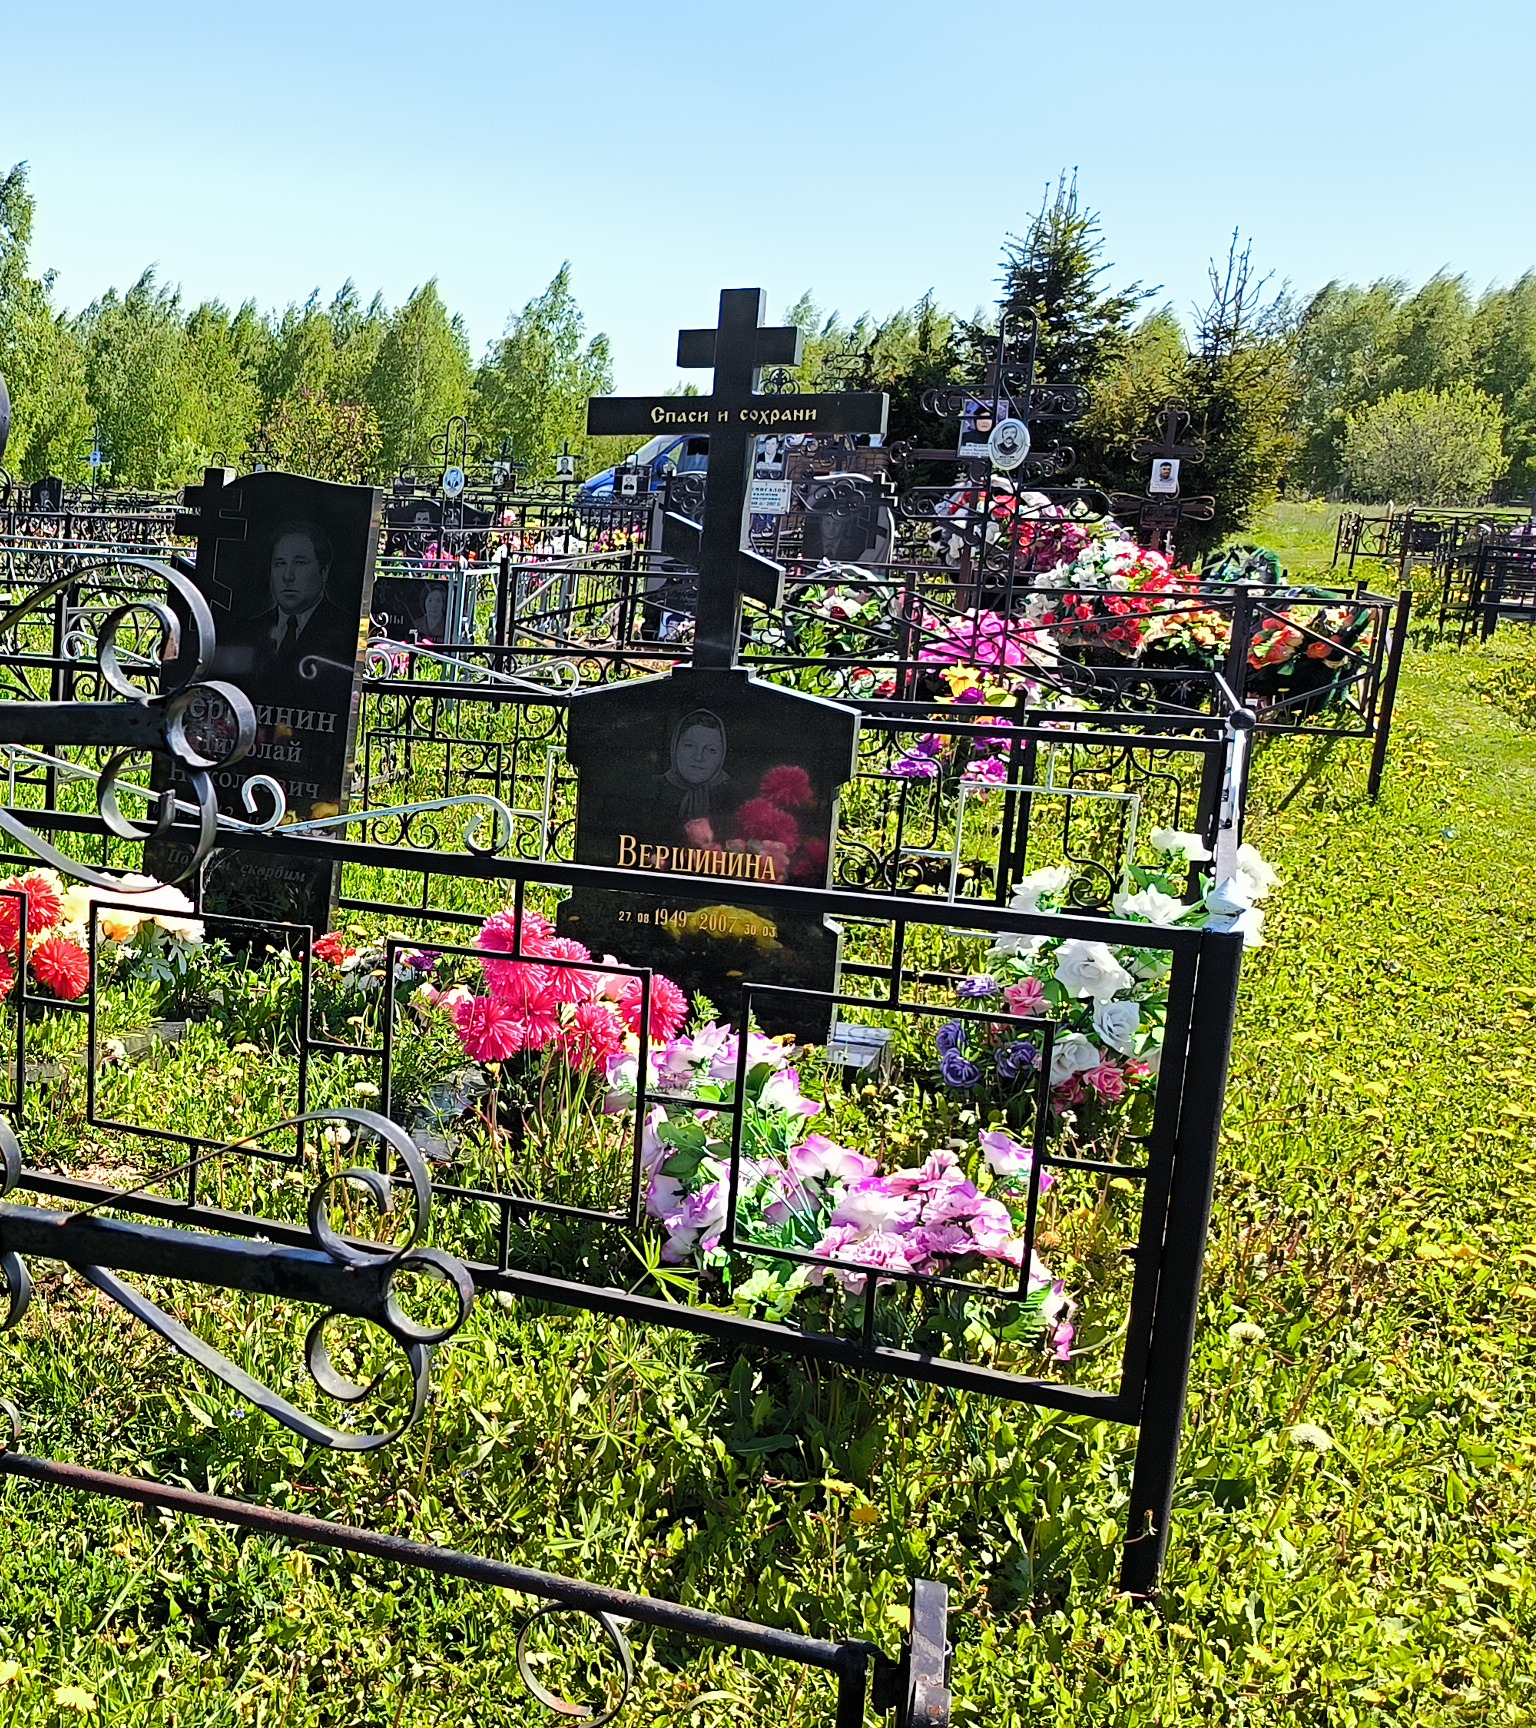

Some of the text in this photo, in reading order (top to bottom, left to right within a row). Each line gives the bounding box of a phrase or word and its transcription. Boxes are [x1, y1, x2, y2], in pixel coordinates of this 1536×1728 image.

[650, 406, 818, 425] Спаси и сохрани
[654, 907, 687, 928] 1949
[699, 912, 739, 933] 2007
